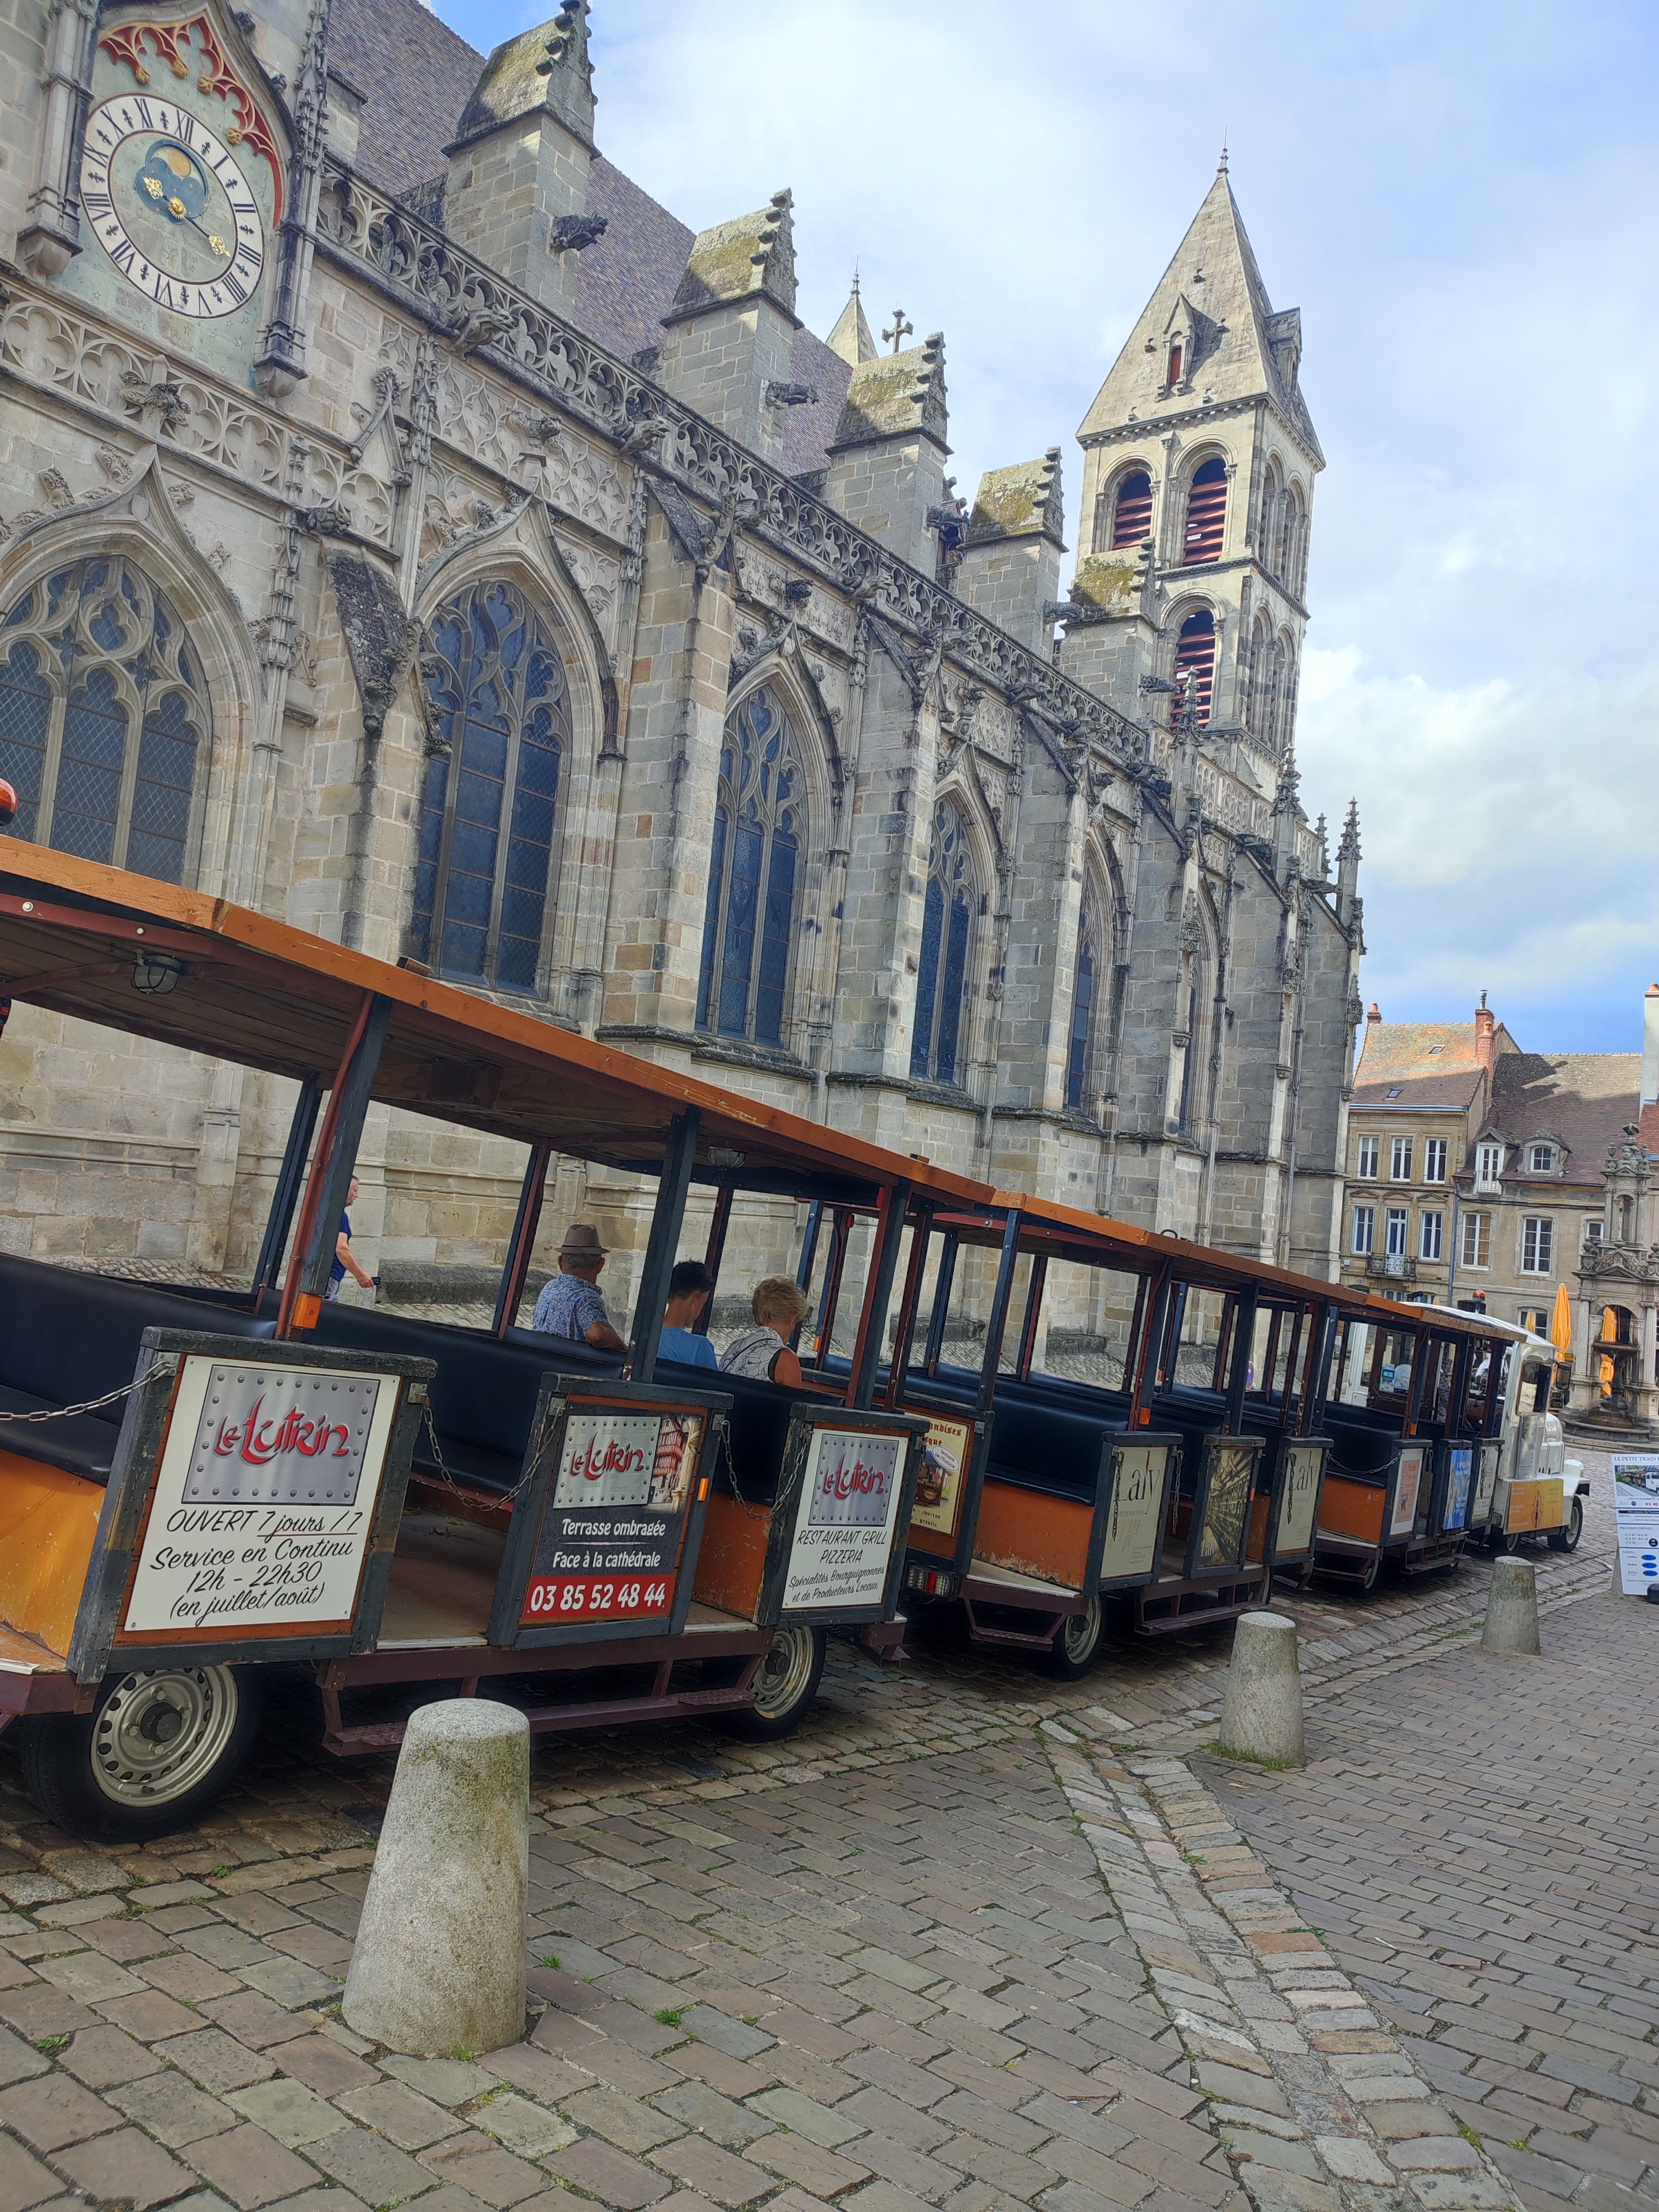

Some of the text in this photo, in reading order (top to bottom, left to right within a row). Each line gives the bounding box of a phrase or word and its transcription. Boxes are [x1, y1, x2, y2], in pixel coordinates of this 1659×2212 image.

[940, 1448, 955, 1463] Terrasse
[166, 1510, 258, 1532] OUVERT
[258, 1511, 275, 1532] 7
[919, 1517, 937, 1527] granita
[922, 1510, 941, 1519] churros
[265, 1512, 325, 1543] jours
[562, 1519, 666, 1536] Terrasse ombragée
[796, 1530, 887, 1545] RESTAURANT GRILL
[150, 1538, 353, 1571] Service en Continu
[553, 1550, 661, 1568] Face à la cathédrale
[820, 1550, 864, 1564] PIZZERIA
[186, 1568, 226, 1594] 12h
[249, 1561, 322, 1588] 22h30
[789, 1565, 885, 1589] Spécialités Bourguignonnes
[531, 1583, 666, 1611] 03 85 52 48 44
[792, 1582, 879, 1603] et de Producteurs Locaux
[170, 1583, 327, 1626] (en juillet/août)
